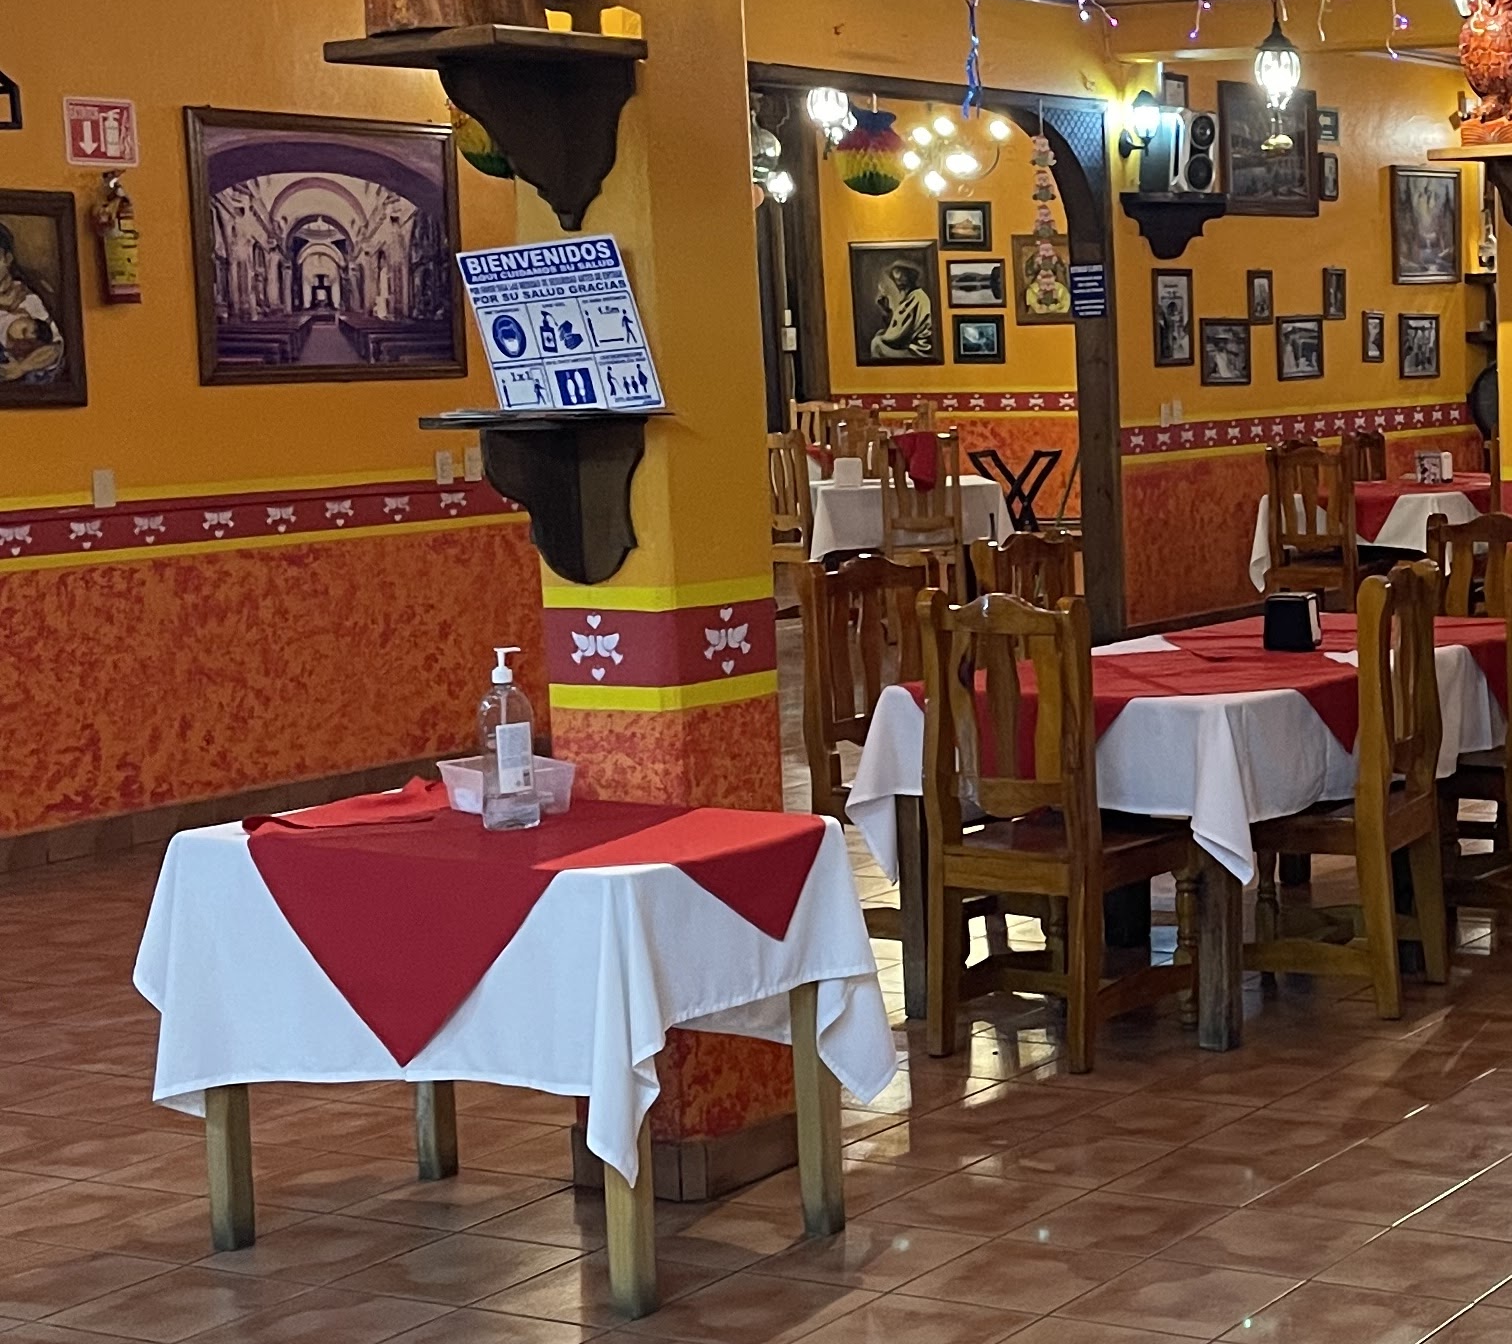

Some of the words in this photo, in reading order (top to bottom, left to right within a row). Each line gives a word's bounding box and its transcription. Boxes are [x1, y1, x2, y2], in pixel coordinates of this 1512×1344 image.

[466, 242, 611, 275] BIENVENIDOS
[501, 266, 558, 279] CUIDAMOS
[560, 263, 575, 272] SU
[579, 259, 615, 270] SALUD
[473, 294, 498, 305] POR
[503, 291, 519, 302] SU
[523, 286, 565, 300] SALUD
[569, 279, 627, 294] GRACIAS
